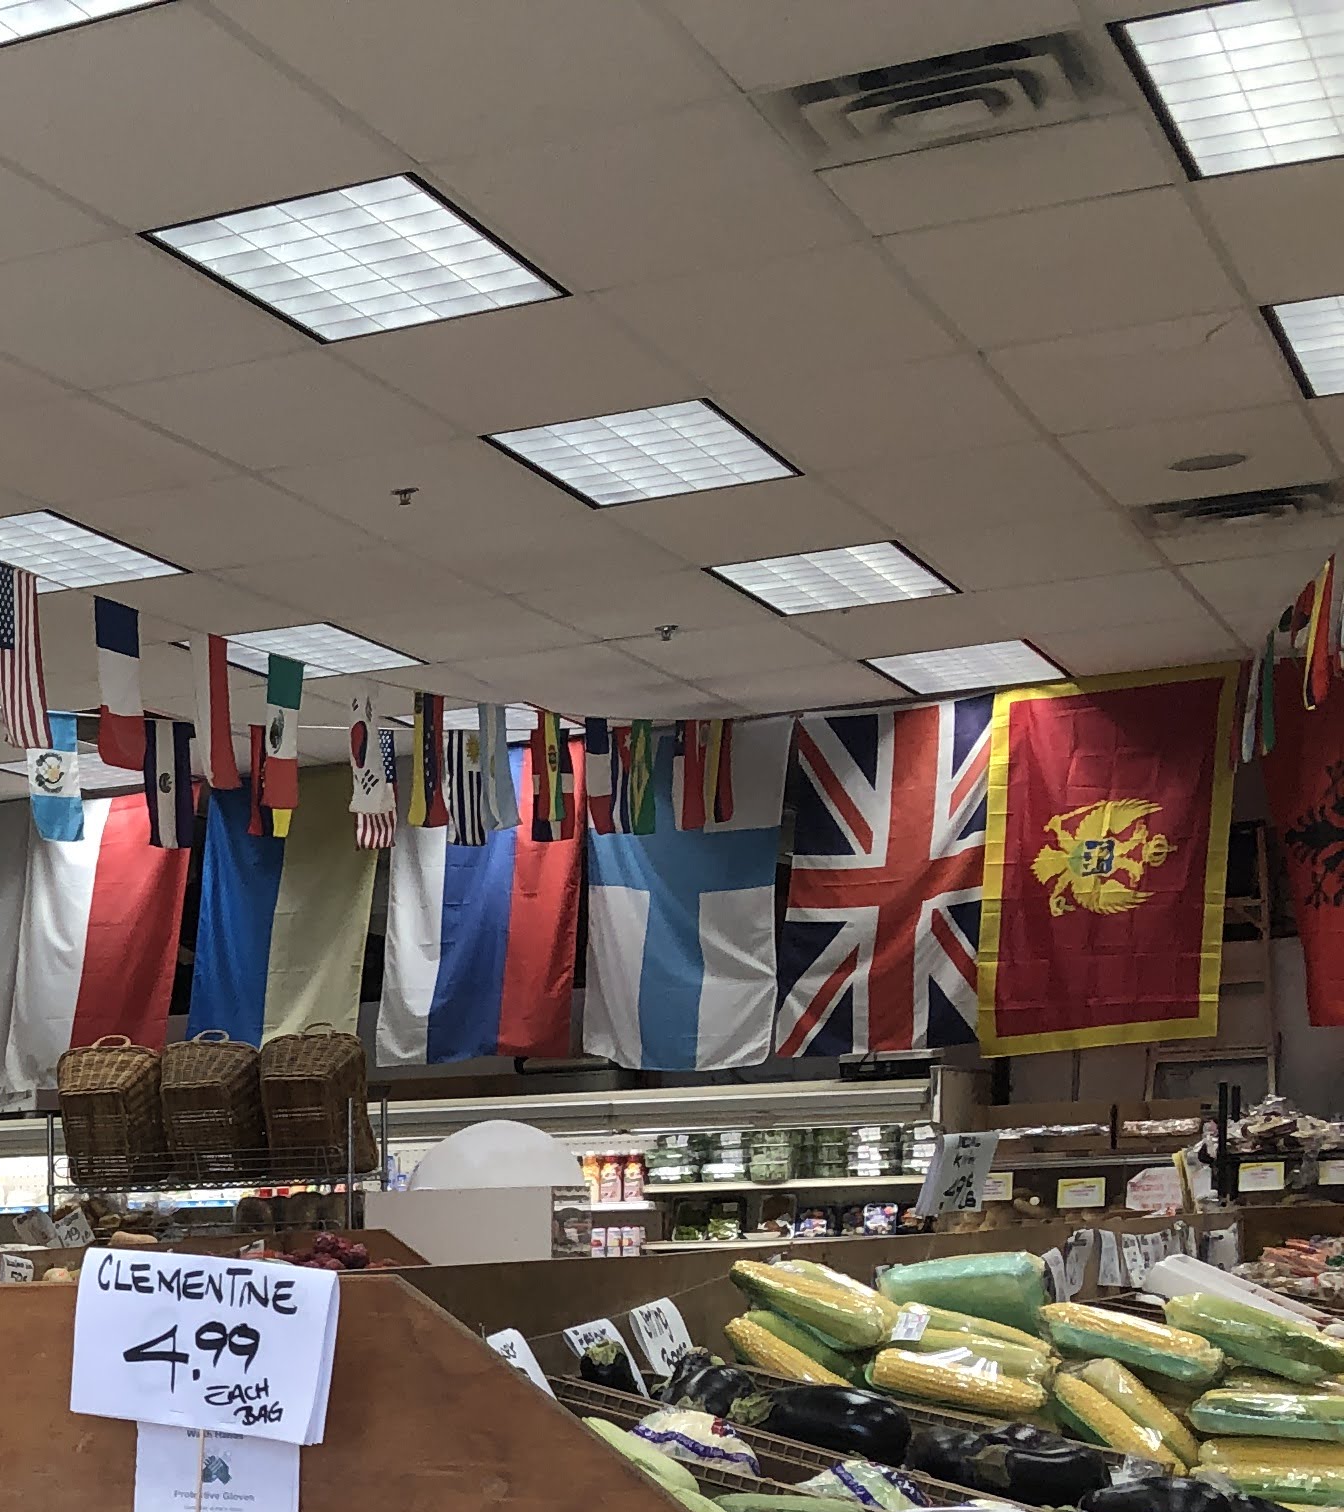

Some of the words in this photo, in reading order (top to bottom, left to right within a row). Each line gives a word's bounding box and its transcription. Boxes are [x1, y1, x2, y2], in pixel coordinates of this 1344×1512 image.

[98, 1254, 298, 1315] CLEMENTINE
[123, 1321, 261, 1394] 4.99
[204, 1377, 270, 1405] EACH
[234, 1401, 284, 1426] BAG
[222, 1489, 256, 1503] Gloves
